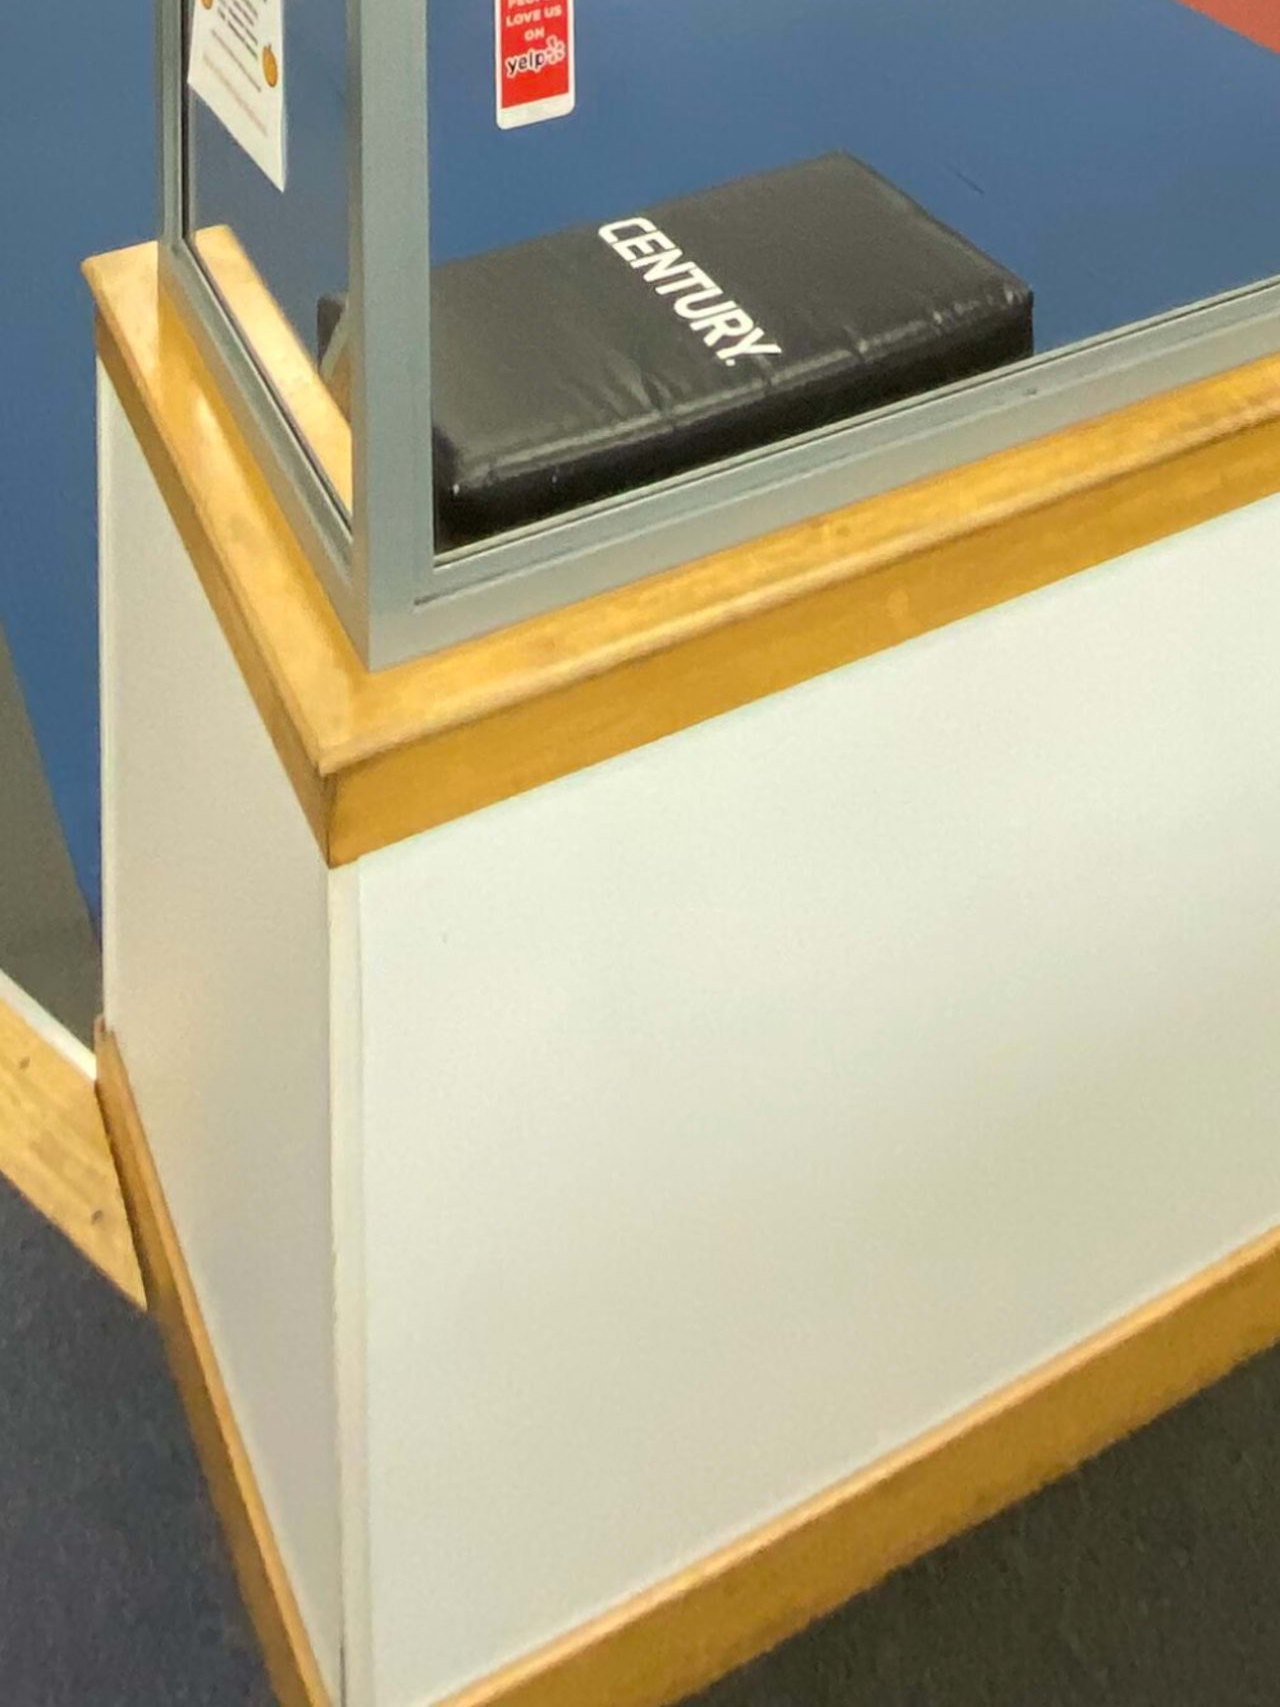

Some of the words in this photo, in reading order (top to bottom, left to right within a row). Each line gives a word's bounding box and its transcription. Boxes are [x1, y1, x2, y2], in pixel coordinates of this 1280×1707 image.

[505, 8, 542, 28] LOVE
[544, 4, 563, 20] US
[524, 27, 545, 42] ON
[506, 48, 548, 77] yelp
